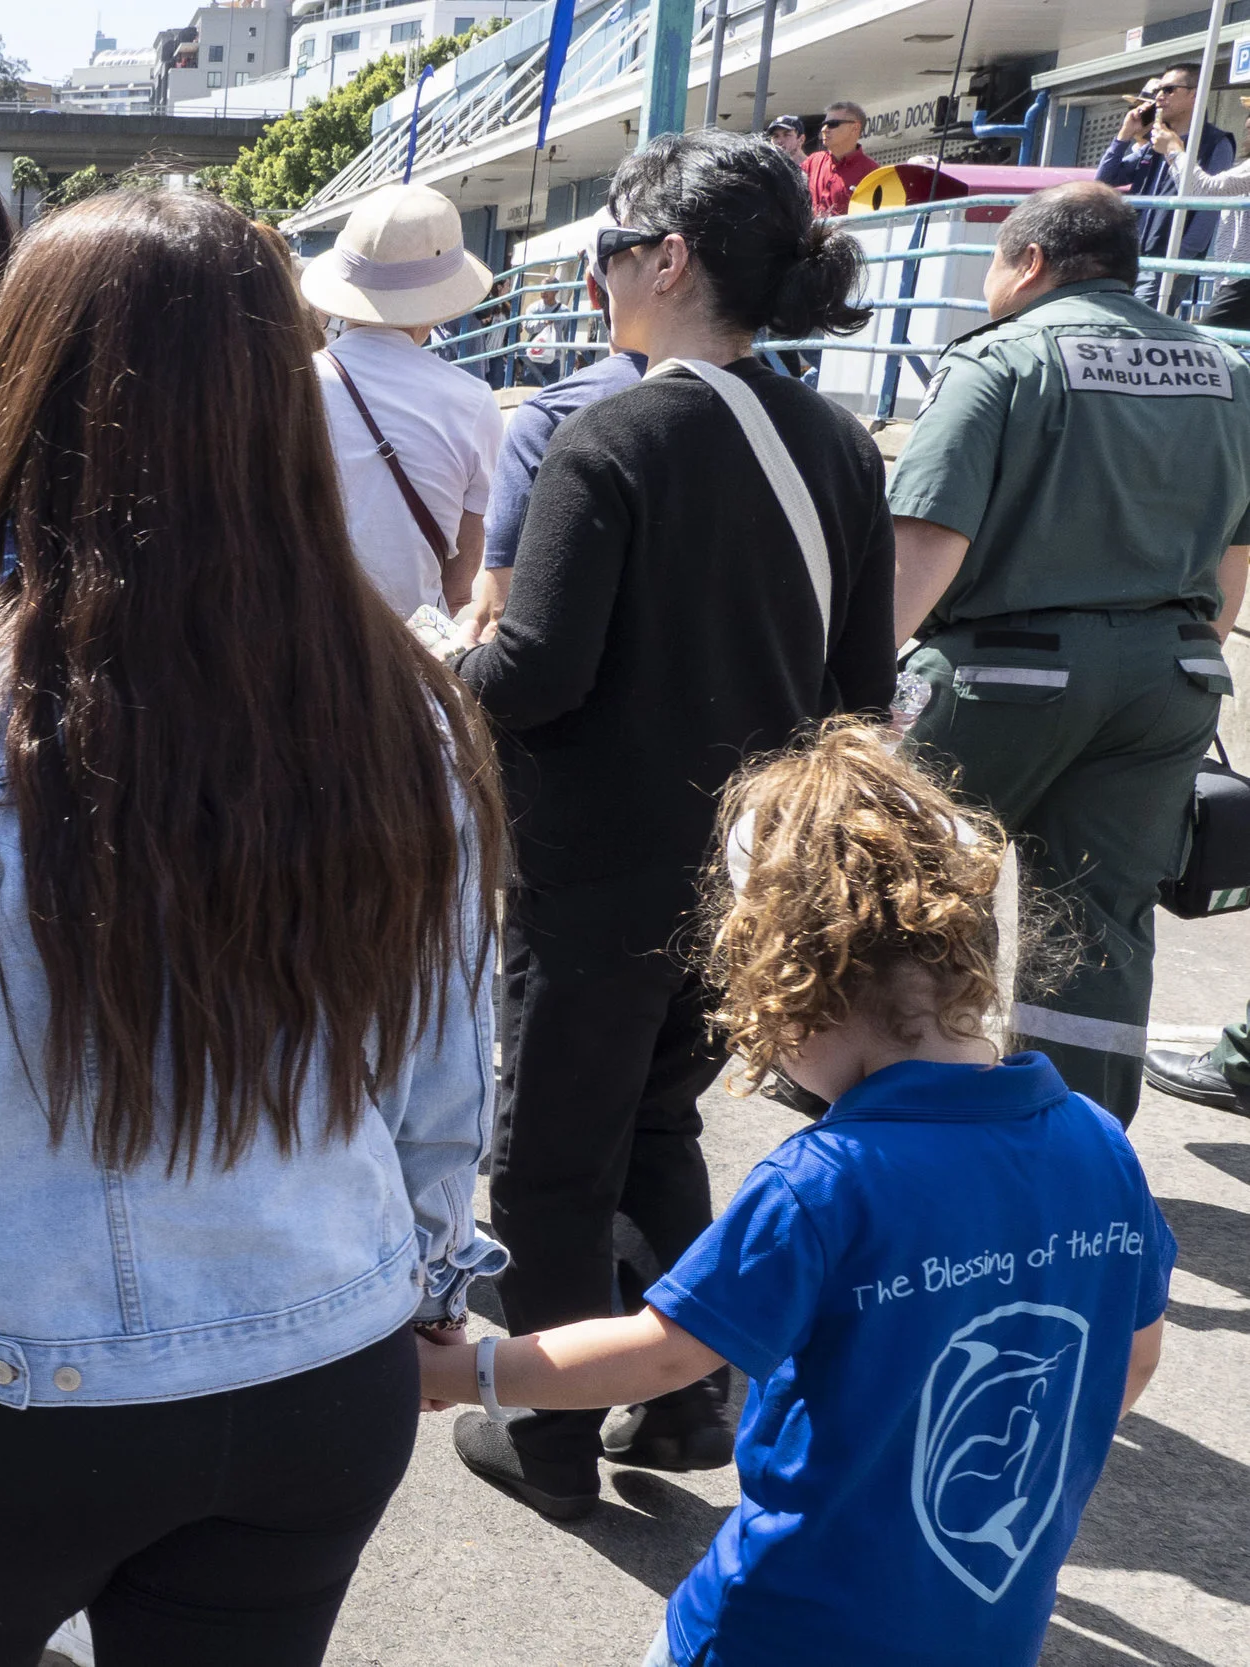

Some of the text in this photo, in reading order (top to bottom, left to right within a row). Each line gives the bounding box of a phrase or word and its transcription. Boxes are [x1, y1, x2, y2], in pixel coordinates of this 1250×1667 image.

[860, 100, 937, 139] OADING DOCK
[1076, 343, 1218, 369] ST JOHN
[1081, 366, 1222, 388] AMBULANCE
[852, 1274, 914, 1311] The
[921, 1249, 1015, 1293] Blessing
[1027, 1233, 1059, 1267] of
[1066, 1230, 1103, 1259] the
